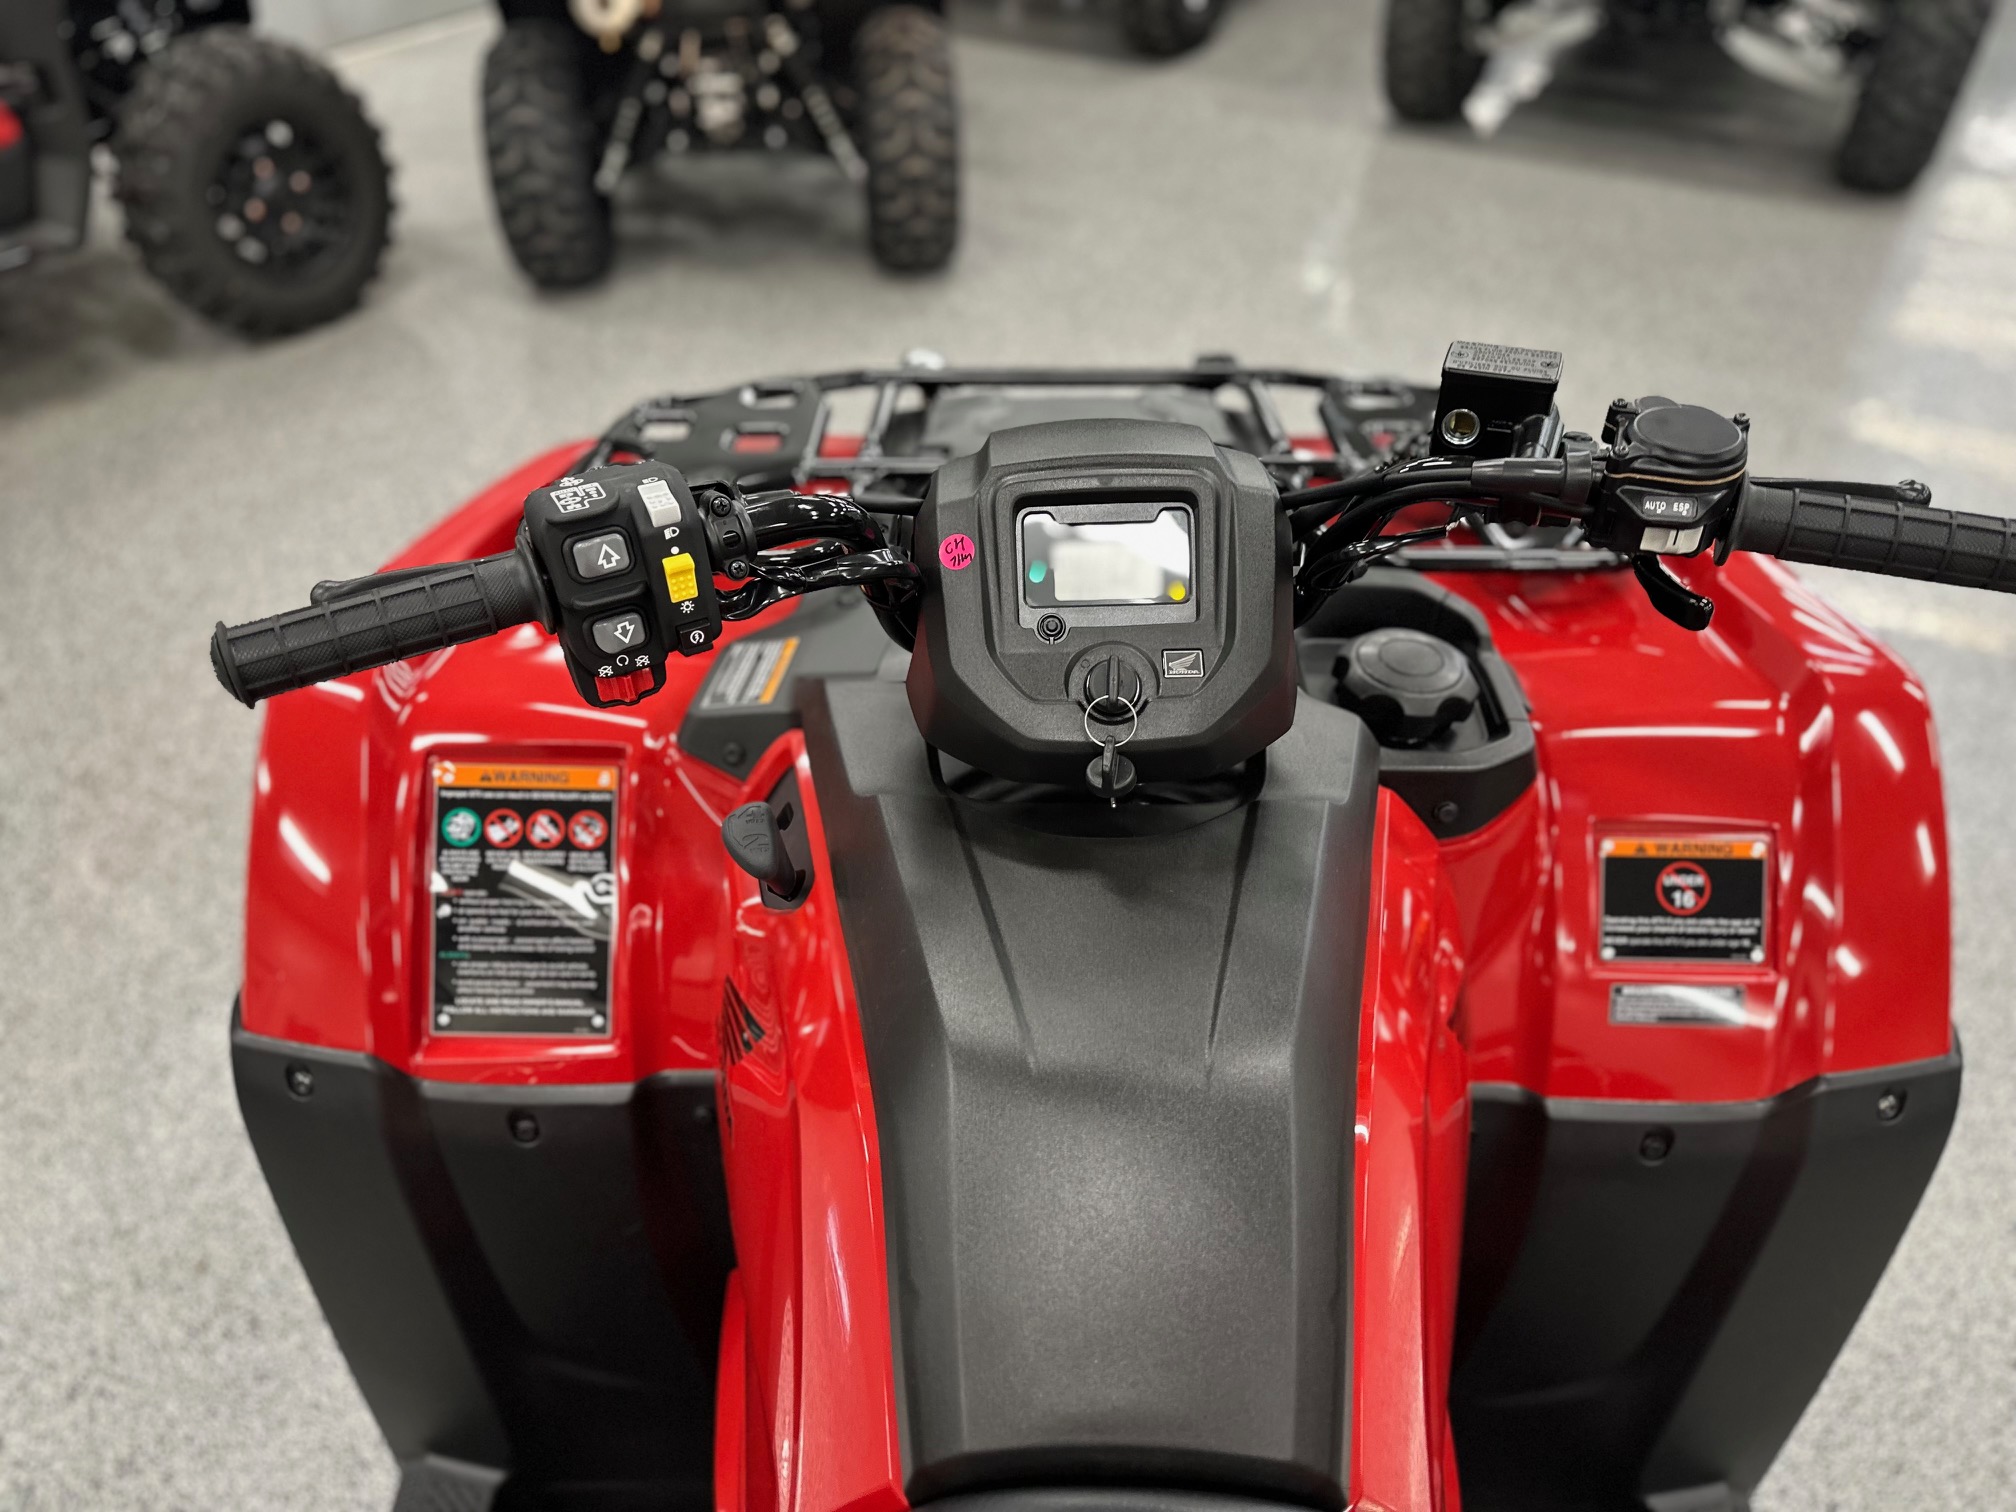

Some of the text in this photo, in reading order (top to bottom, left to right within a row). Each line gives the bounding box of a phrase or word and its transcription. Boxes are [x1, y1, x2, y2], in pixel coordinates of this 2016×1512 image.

[1644, 500, 1690, 512] AUTO ESP
[494, 771, 569, 784] WARNING
[1655, 842, 1734, 858] WARNING
[1671, 889, 1697, 910] 16
